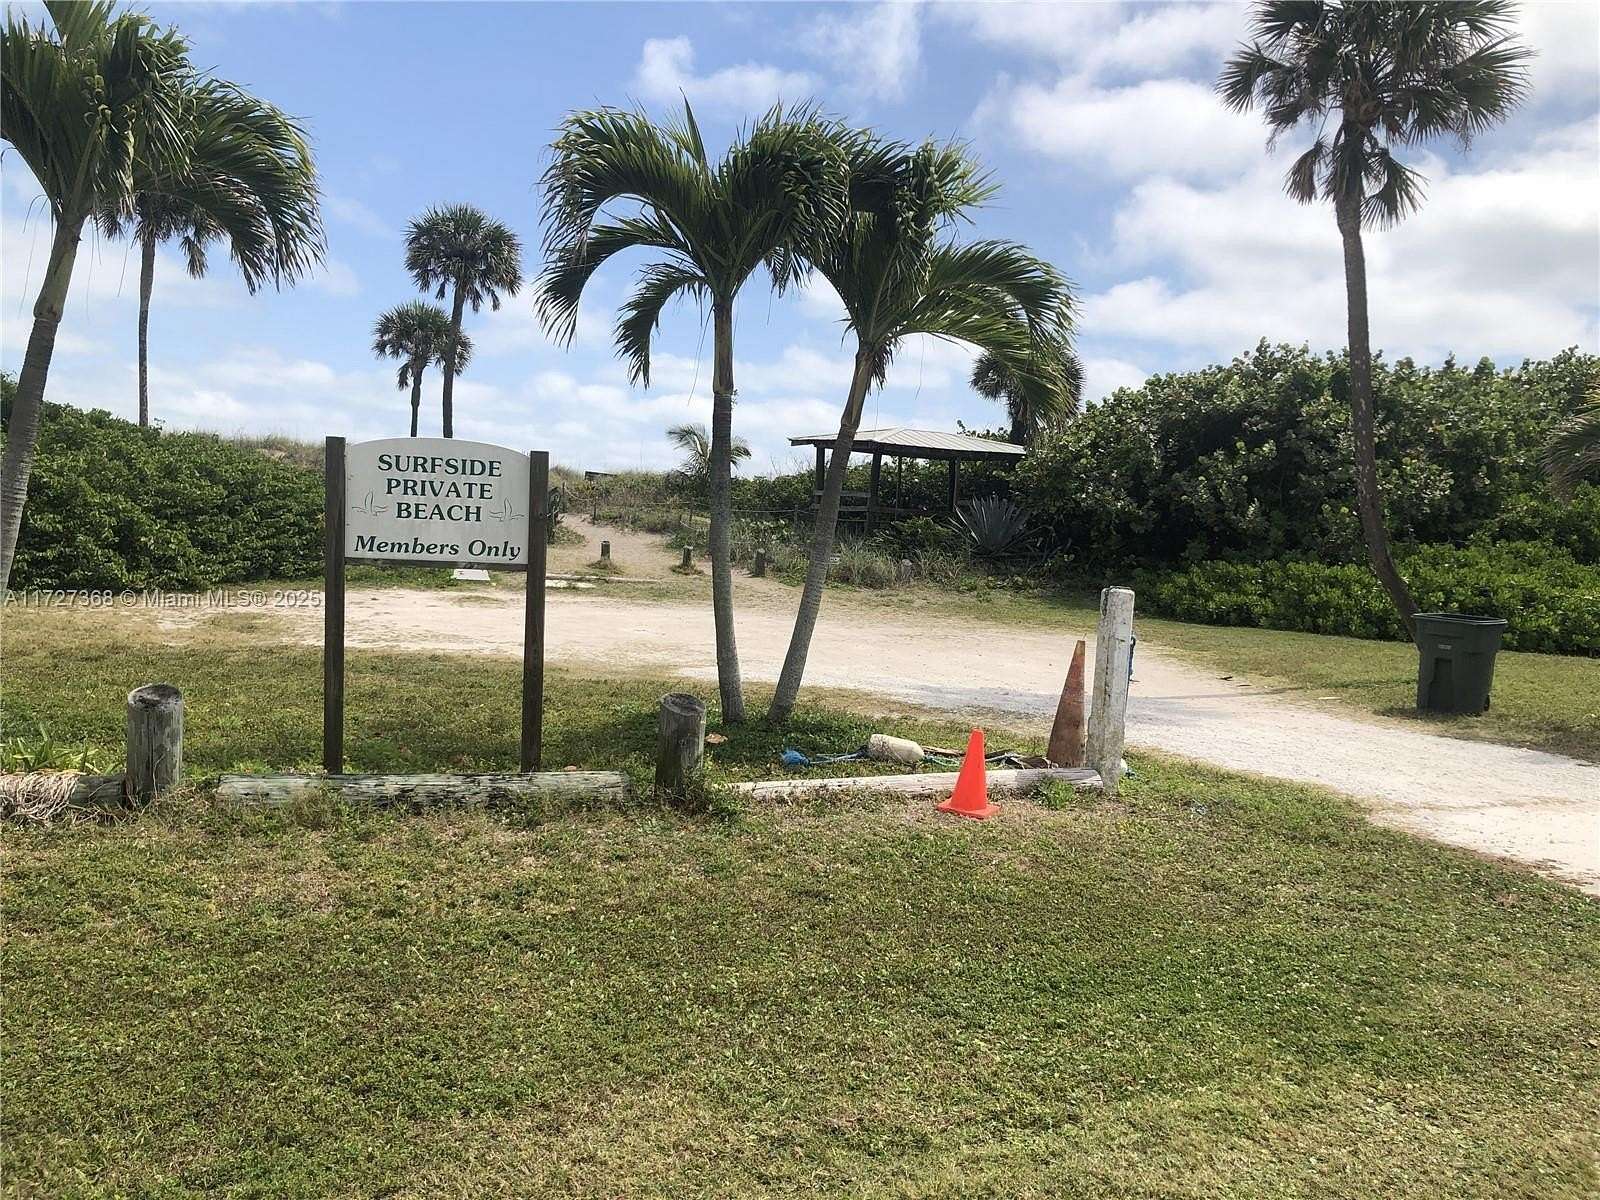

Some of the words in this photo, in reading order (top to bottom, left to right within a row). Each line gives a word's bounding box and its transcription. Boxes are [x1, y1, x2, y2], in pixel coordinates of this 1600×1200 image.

[377, 454, 502, 477] SURFSIDE
[386, 478, 493, 499] PRIVATE
[396, 502, 482, 522] BEACH
[354, 535, 460, 556] Members
[468, 539, 521, 561] Only
